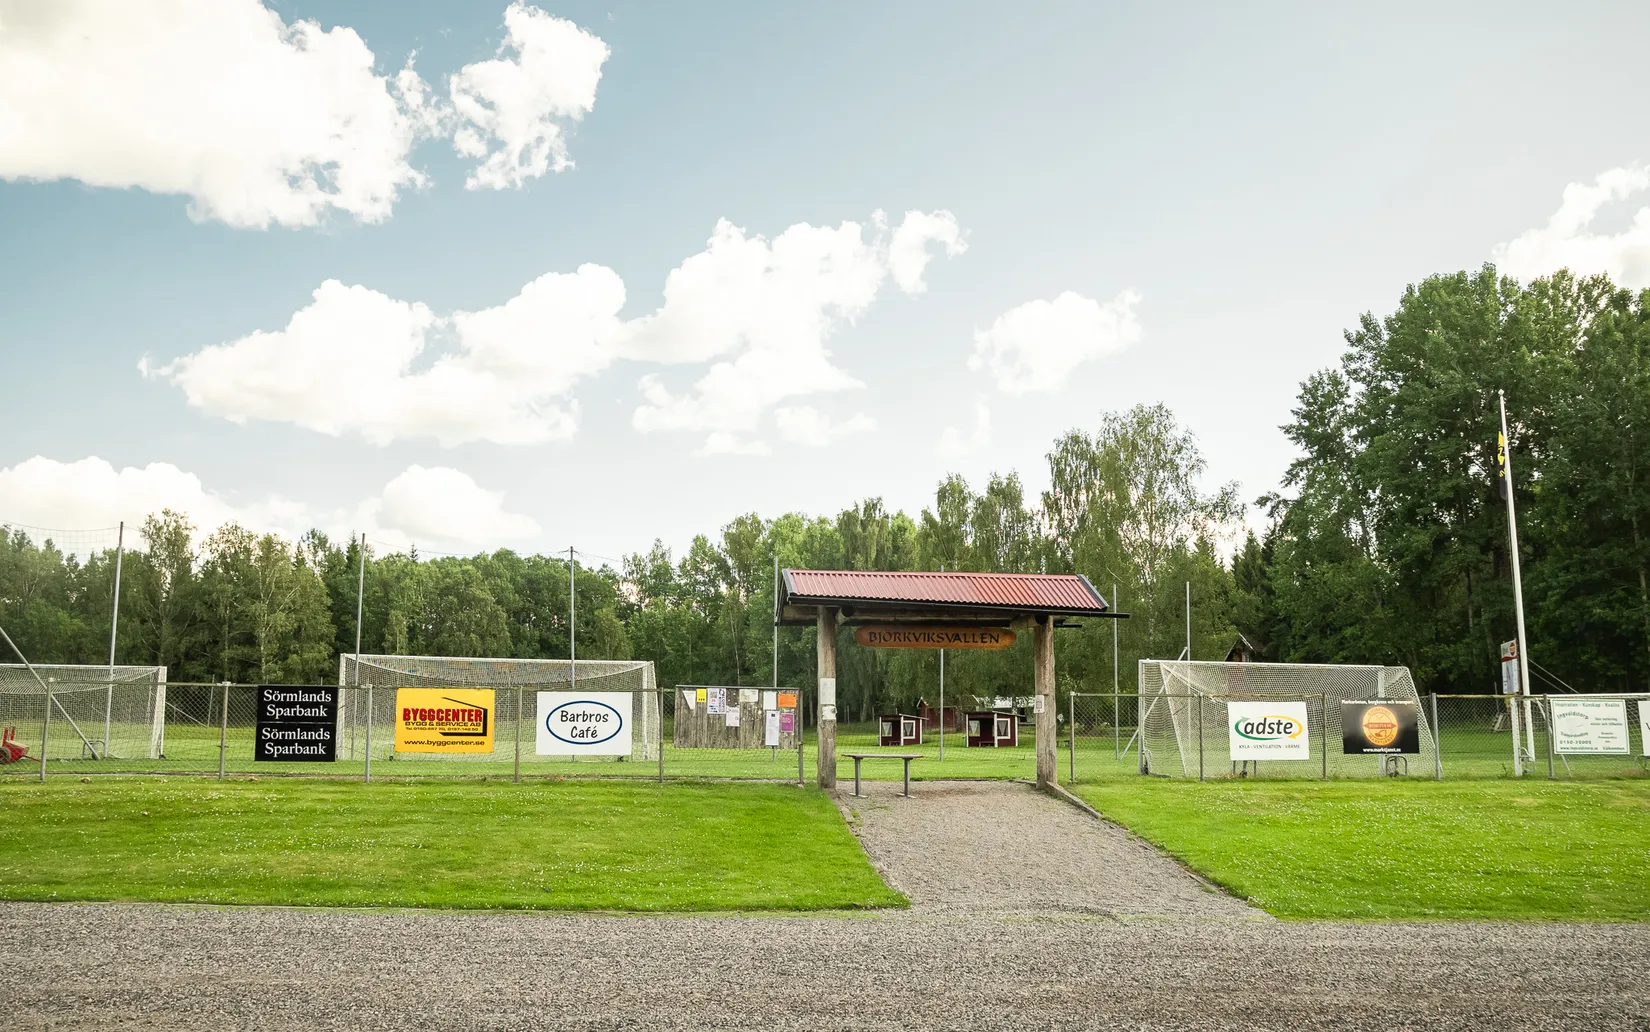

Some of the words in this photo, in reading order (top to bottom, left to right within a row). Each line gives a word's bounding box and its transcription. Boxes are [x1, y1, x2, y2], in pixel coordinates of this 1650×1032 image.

[263, 689, 332, 702] Sörmlands
[266, 704, 328, 719] Sparbank
[402, 708, 483, 722] BYGGCENTER
[560, 710, 609, 723] Barbros
[570, 725, 598, 739] Café
[1244, 717, 1293, 735] adste
[261, 727, 331, 740] Sörmlands
[264, 742, 327, 758] Sparbank
[403, 739, 485, 747] www.byggcenter.se
